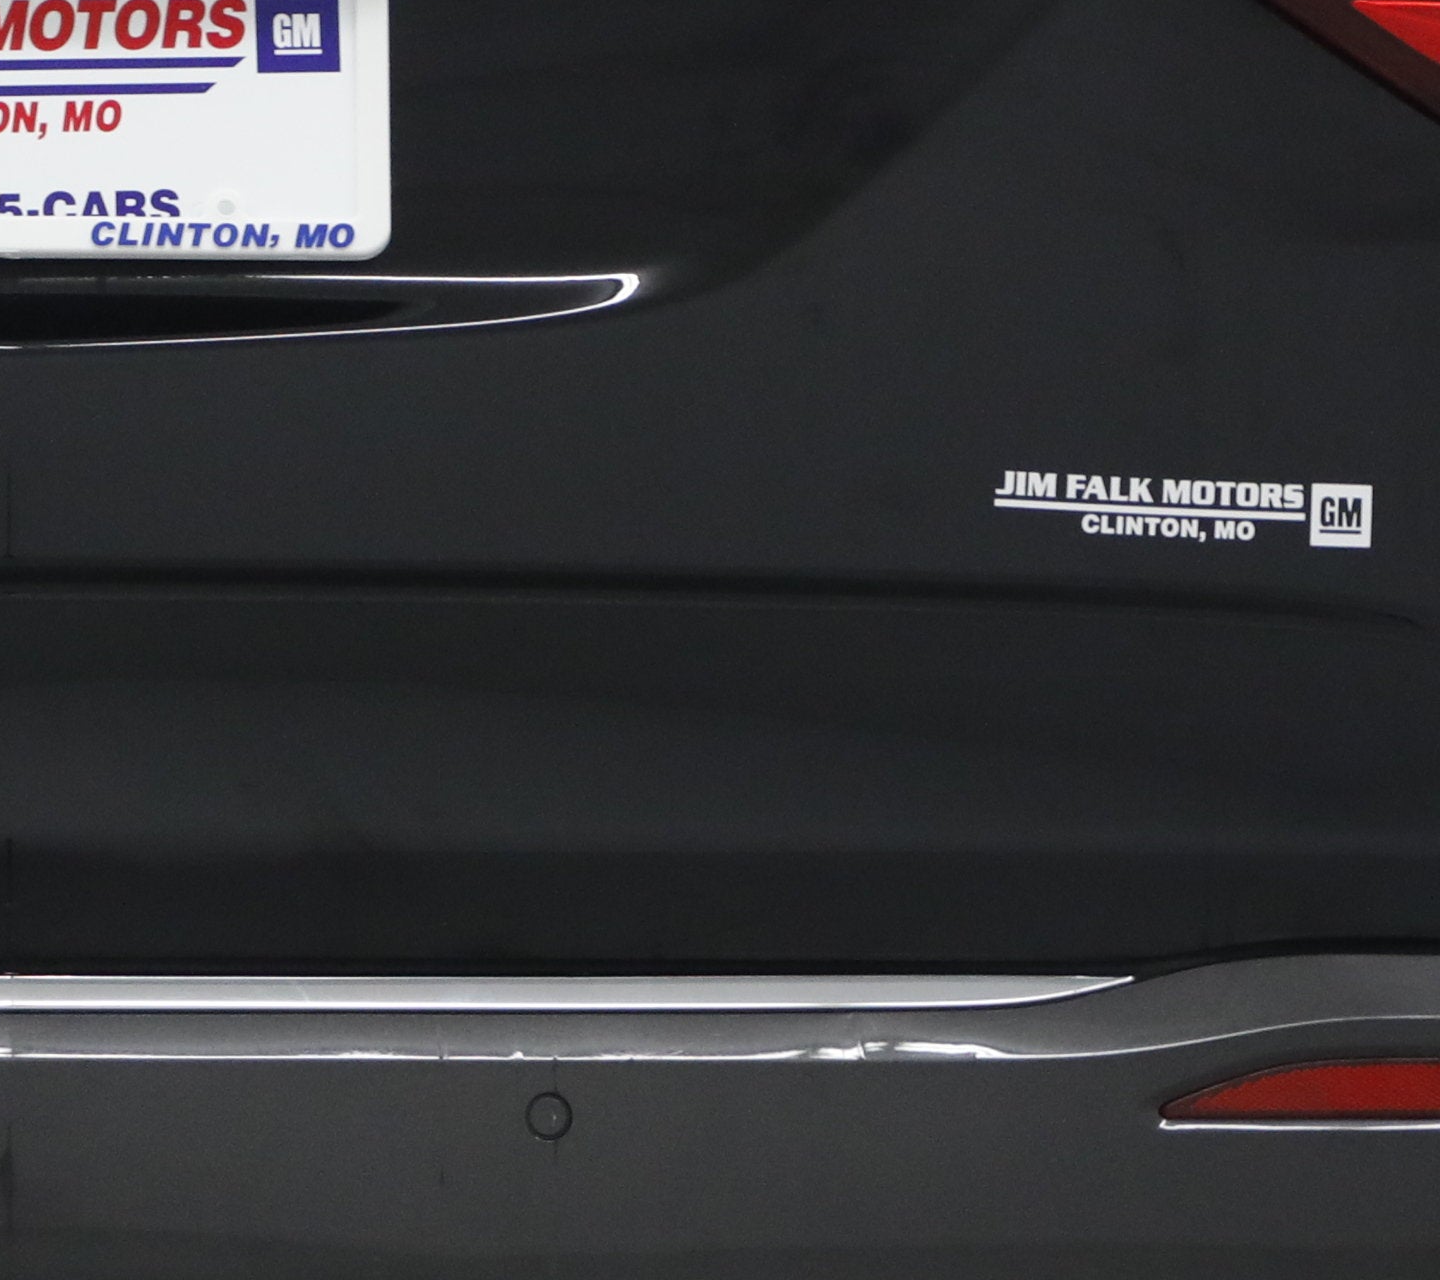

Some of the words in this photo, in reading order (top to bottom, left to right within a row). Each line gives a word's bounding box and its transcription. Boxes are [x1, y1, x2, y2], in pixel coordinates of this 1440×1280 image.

[272, 12, 323, 49] GM
[62, 99, 122, 132] MO
[91, 221, 280, 248] CLINTON,
[295, 223, 356, 248] MO
[995, 470, 1058, 498] JIM
[1066, 474, 1154, 504] FALK
[1161, 478, 1305, 509] MOTORS
[1319, 496, 1362, 528] GM
[1080, 514, 1207, 543] CLINTON,
[1213, 520, 1256, 541] MO
